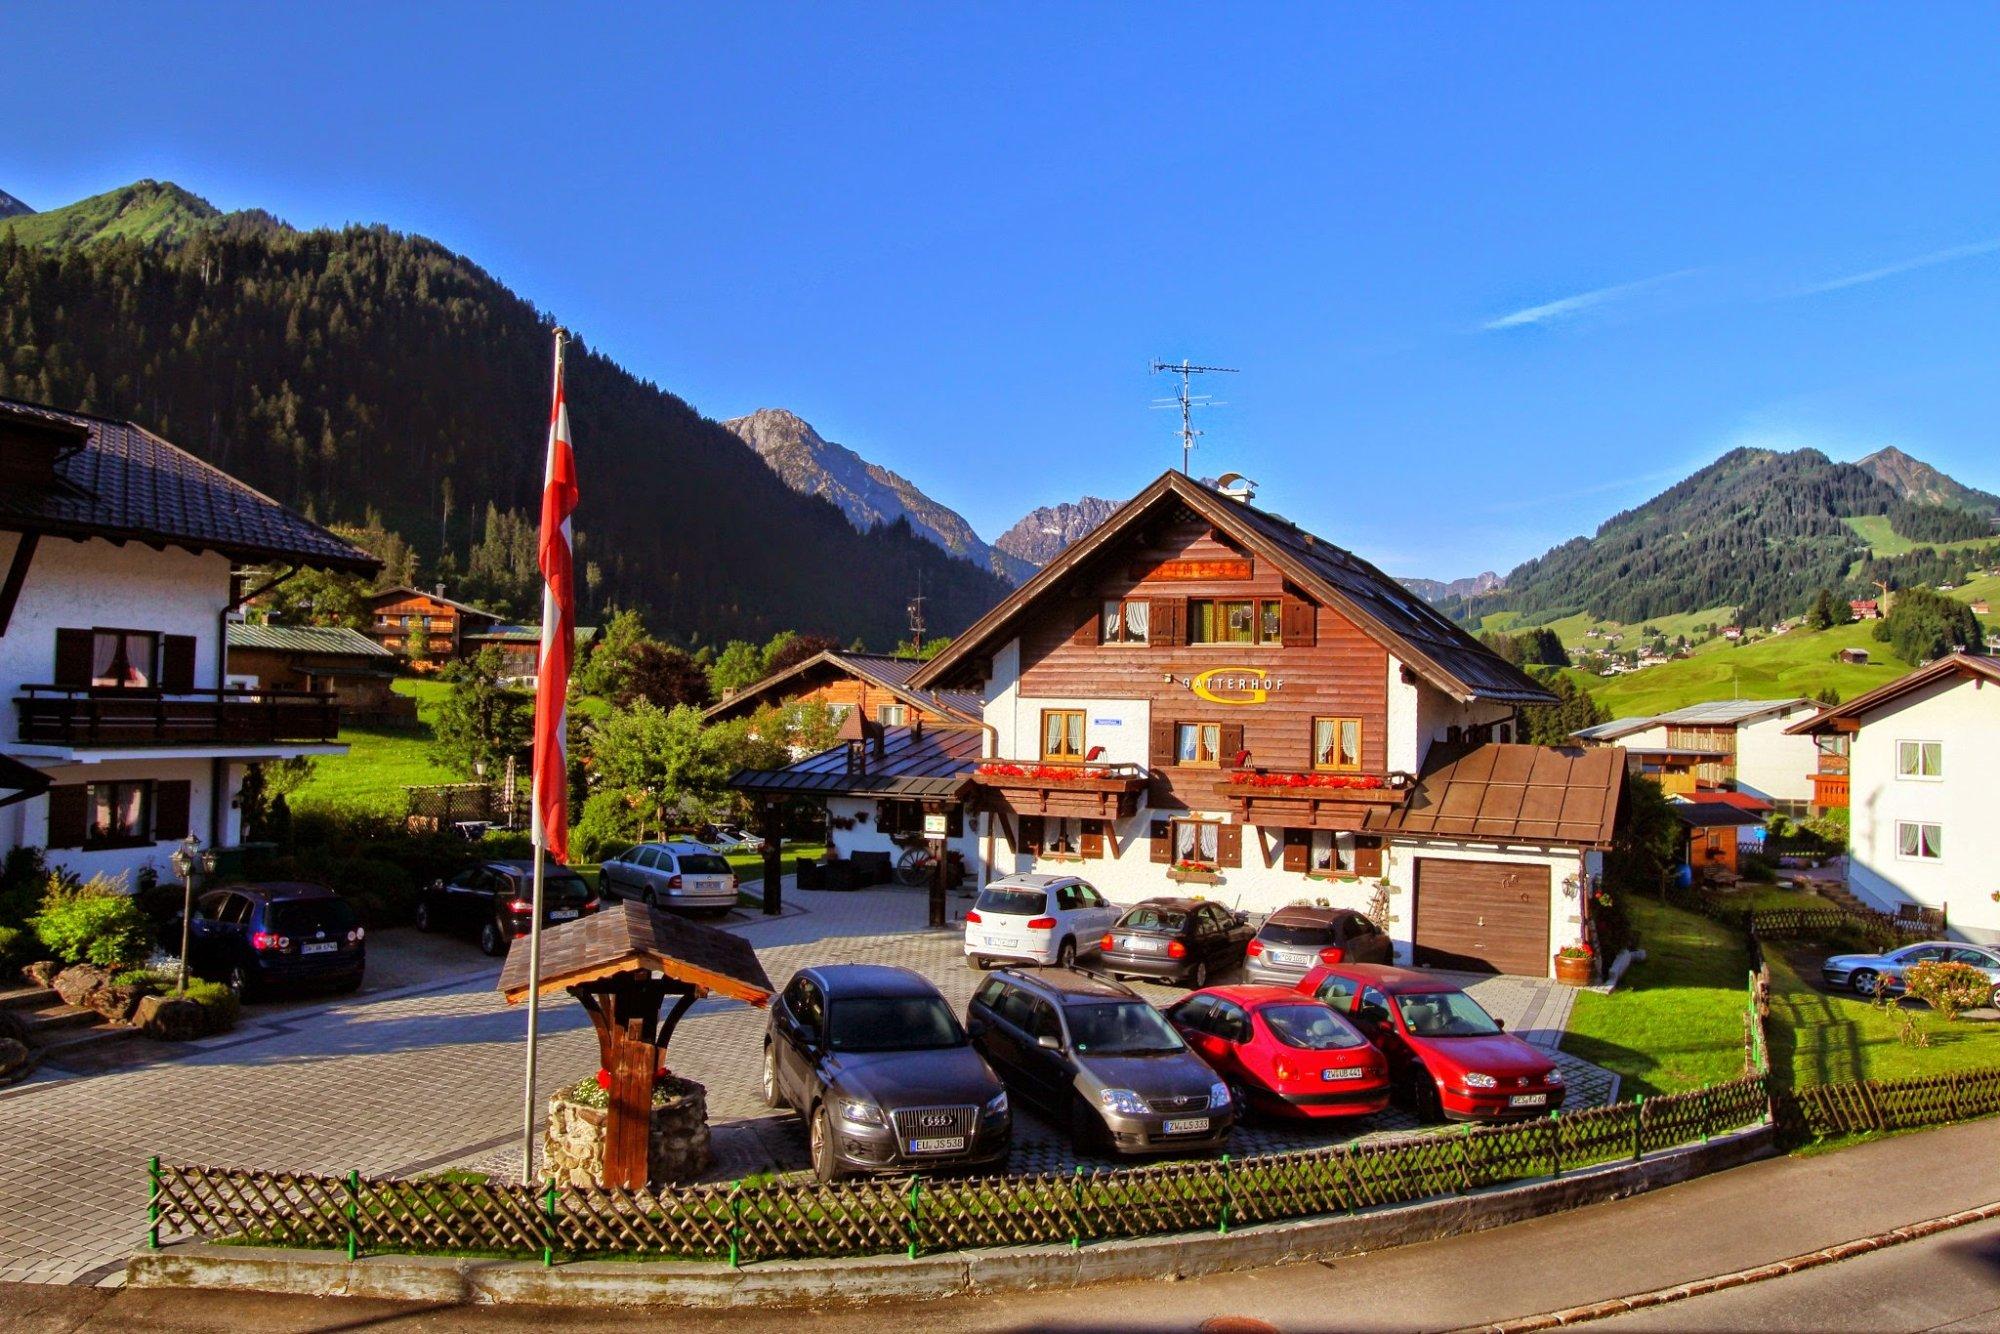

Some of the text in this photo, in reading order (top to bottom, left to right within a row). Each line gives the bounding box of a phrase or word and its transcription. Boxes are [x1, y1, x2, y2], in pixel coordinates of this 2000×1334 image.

[1182, 678, 1284, 691] GATTERHOF
[1183, 1120, 1194, 1130] LS
[1194, 1119, 1208, 1130] 333
[916, 1137, 963, 1151] EU JS 538
